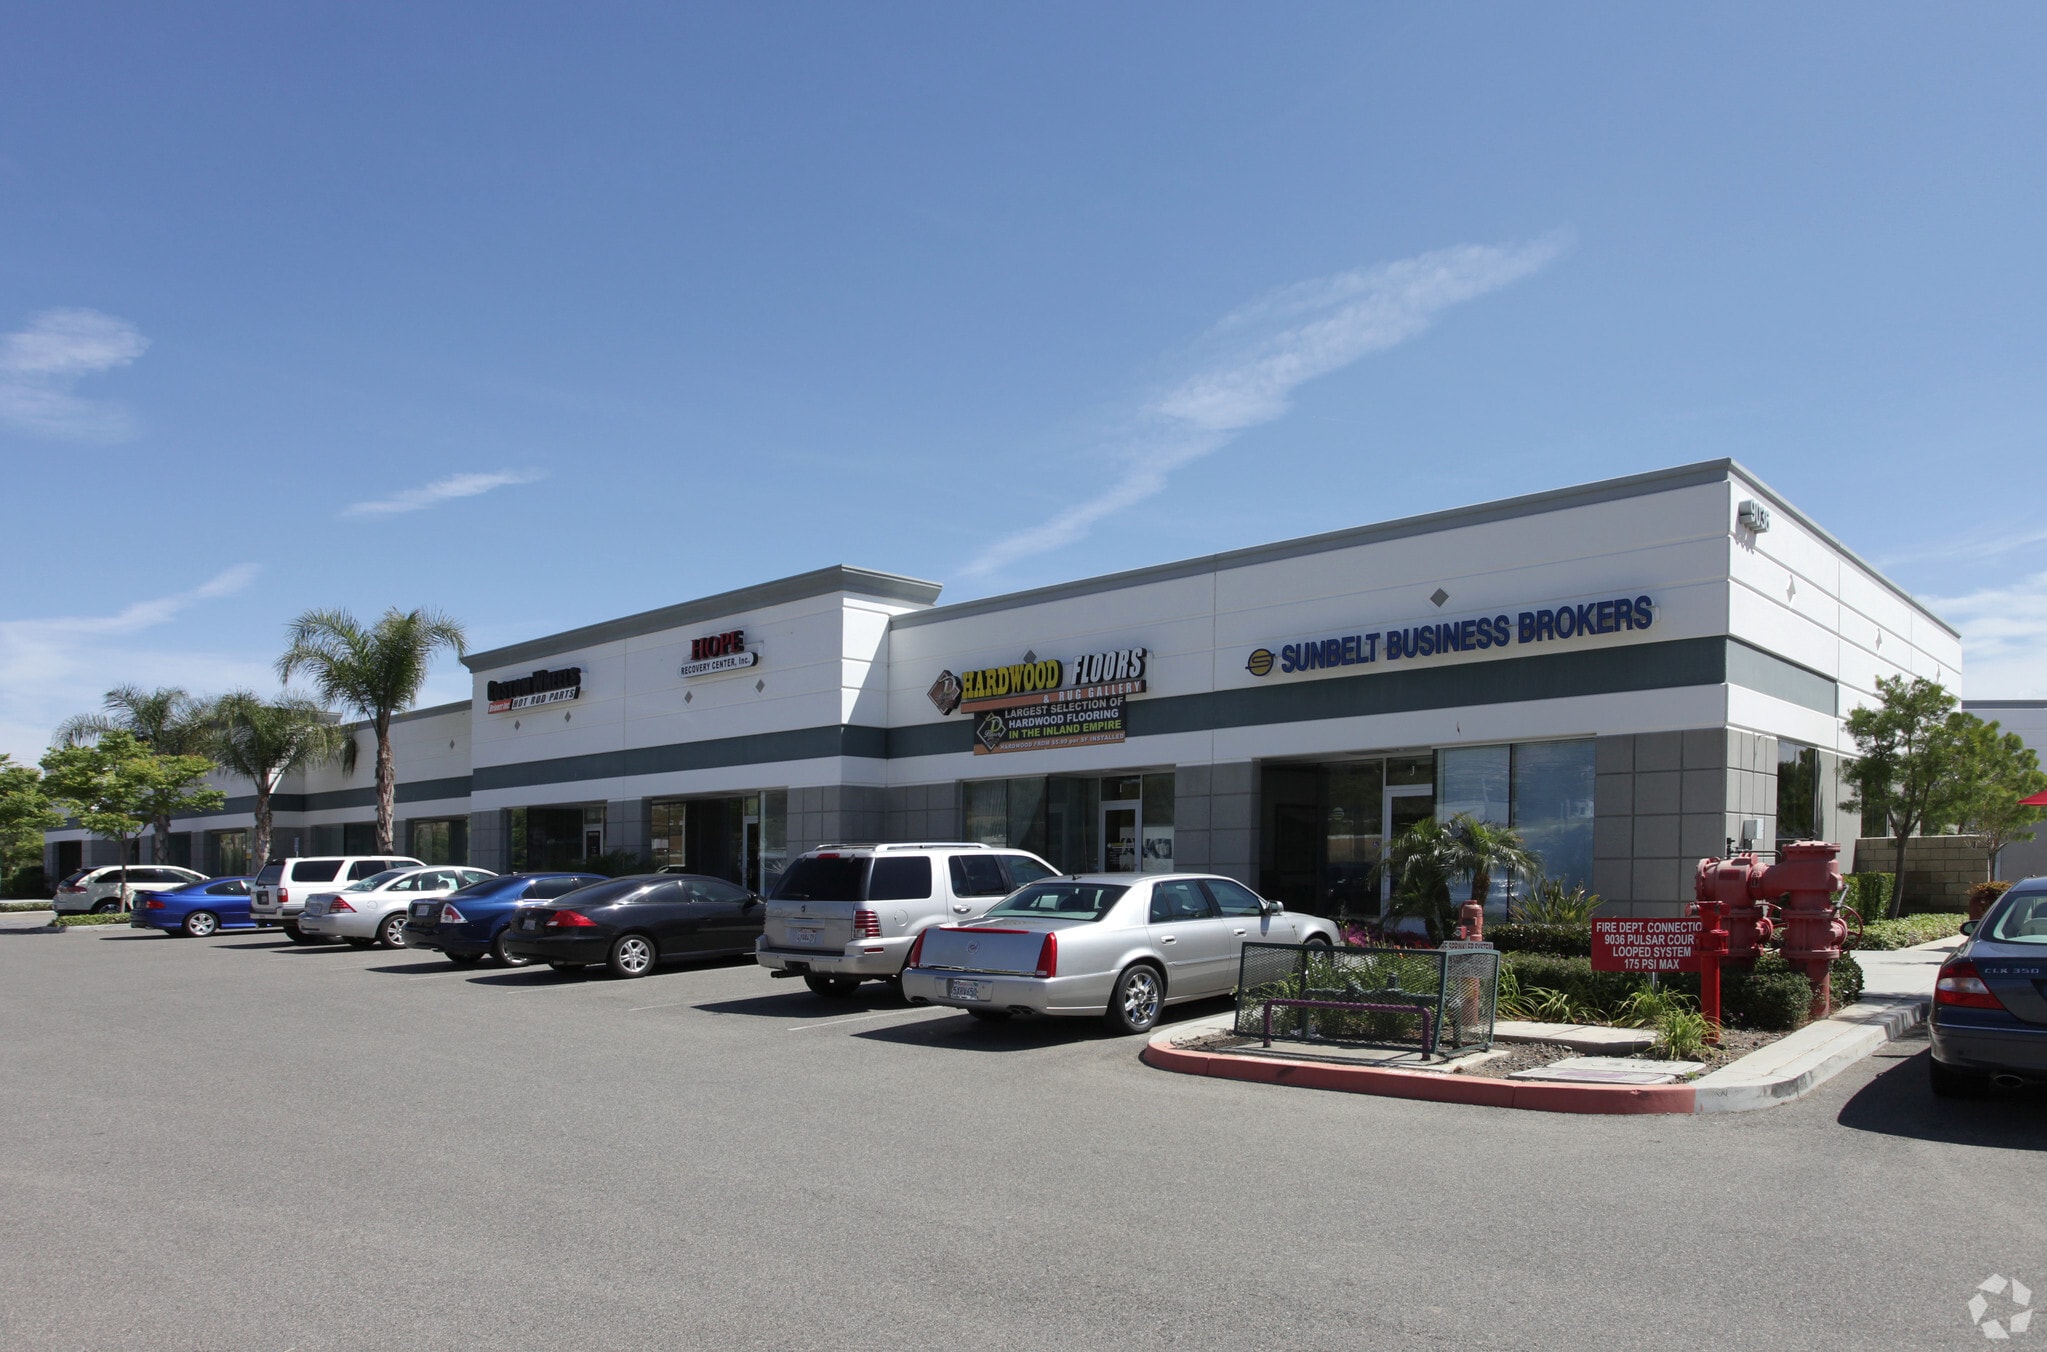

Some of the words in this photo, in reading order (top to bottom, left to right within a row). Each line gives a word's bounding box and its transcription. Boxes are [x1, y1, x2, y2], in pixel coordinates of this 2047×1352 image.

[1281, 632, 1380, 674] SUNBELT
[1387, 614, 1510, 661] BUSINESS
[1517, 595, 1653, 644] BROKERS
[691, 630, 744, 660] HOPE
[681, 663, 710, 675] RECOVERY
[961, 659, 1061, 699] HARDWOOD
[1071, 647, 1145, 685] FLOORS
[513, 698, 529, 708] HOT
[530, 694, 547, 705] ROD
[549, 689, 575, 701] PARTS
[1058, 688, 1082, 702] RUG
[1088, 680, 1142, 698] GALLERY
[1005, 706, 1048, 719] LARGEST
[1050, 699, 1108, 714] SELECTION
[1109, 696, 1124, 707] OF
[1008, 715, 1064, 729] HARDWOOD
[1066, 709, 1119, 723] FLOORING
[1009, 730, 1019, 740] IN
[1021, 728, 1041, 738] THE
[1043, 724, 1080, 736] INLAND
[1083, 719, 1122, 733] EMPIRE
[1000, 742, 1033, 750] HARDWOOD
[1090, 733, 1124, 742] INSTALLED
[1596, 922, 1617, 933] FIRE
[1619, 922, 1645, 933] DEPT.
[1647, 921, 1702, 932] CONNECTIO
[1605, 934, 1625, 945] 9036
[1627, 934, 1665, 945] PULSAR
[1667, 934, 1695, 945] COUR
[1613, 946, 1651, 957] LOOPED
[1653, 946, 1691, 957] SYSTEM
[1624, 959, 1640, 969] 175
[1642, 959, 1656, 970] PSI
[1659, 959, 1680, 969] MAX
